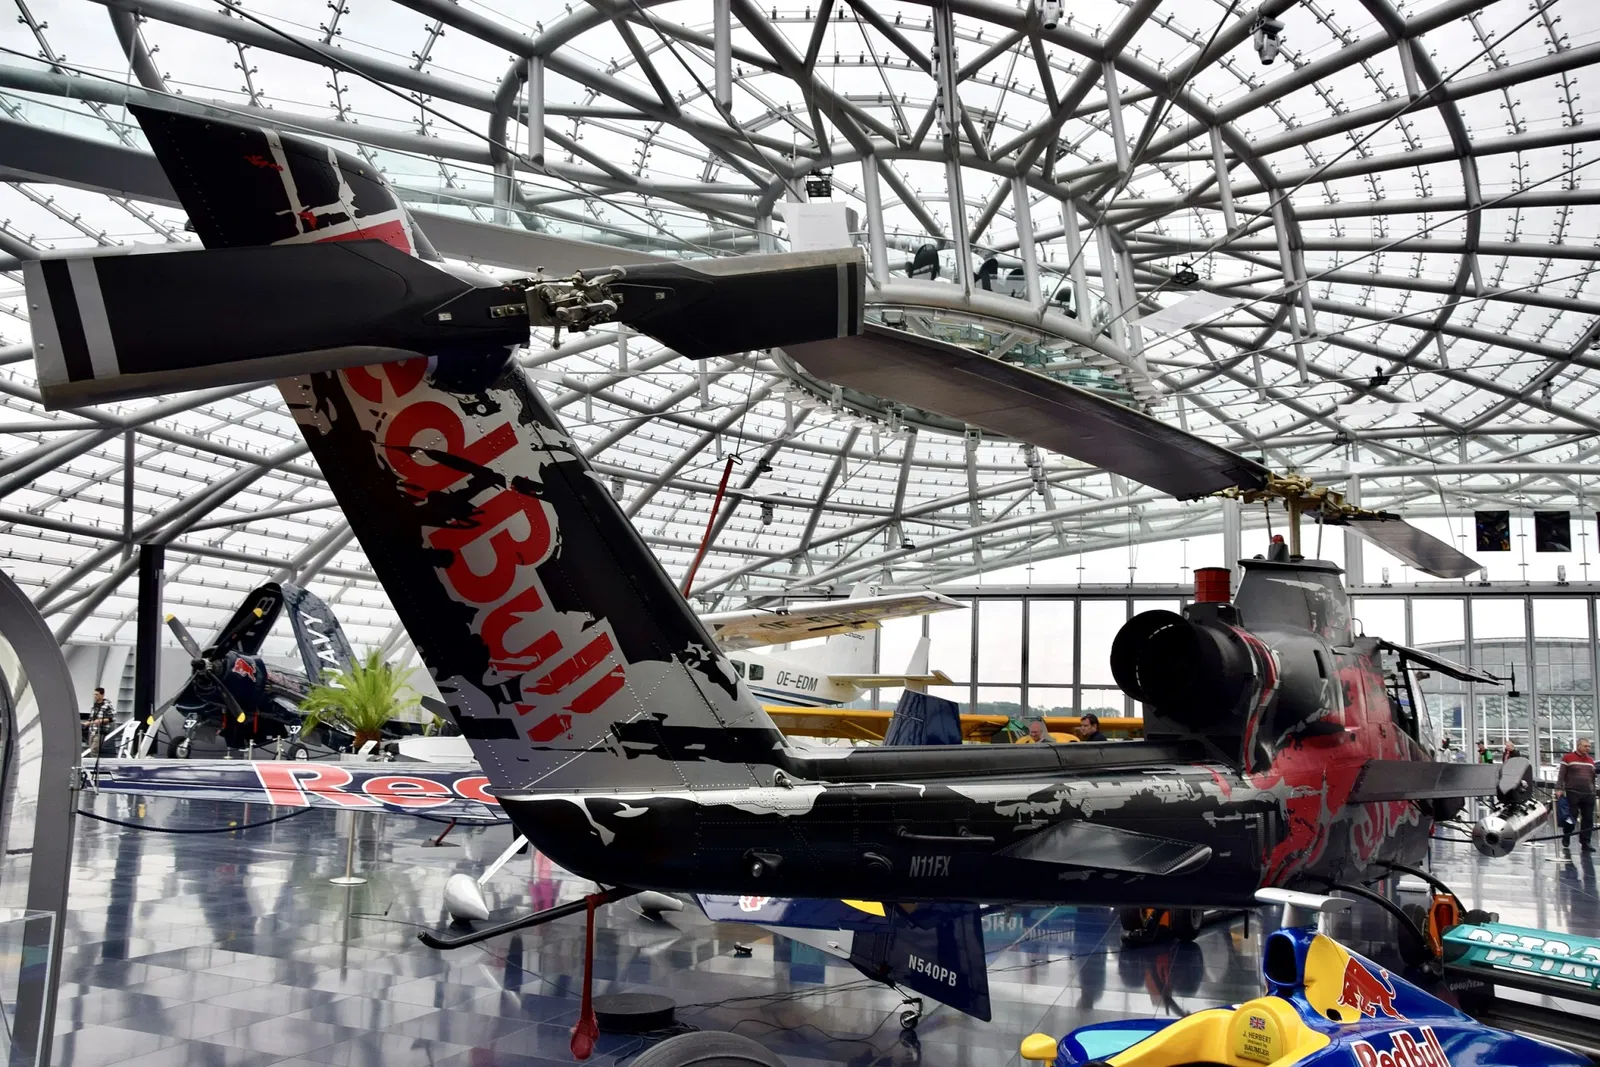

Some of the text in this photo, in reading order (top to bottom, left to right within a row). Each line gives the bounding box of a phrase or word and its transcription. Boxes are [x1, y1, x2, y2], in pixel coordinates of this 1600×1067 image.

[297, 610, 346, 689] NAVY
[776, 670, 818, 692] OE-EDM
[184, 719, 197, 729] 37
[289, 725, 302, 735] 37
[909, 855, 951, 878] N11FX
[908, 954, 957, 987] N540PB
[1248, 1031, 1272, 1044] HERBERT
